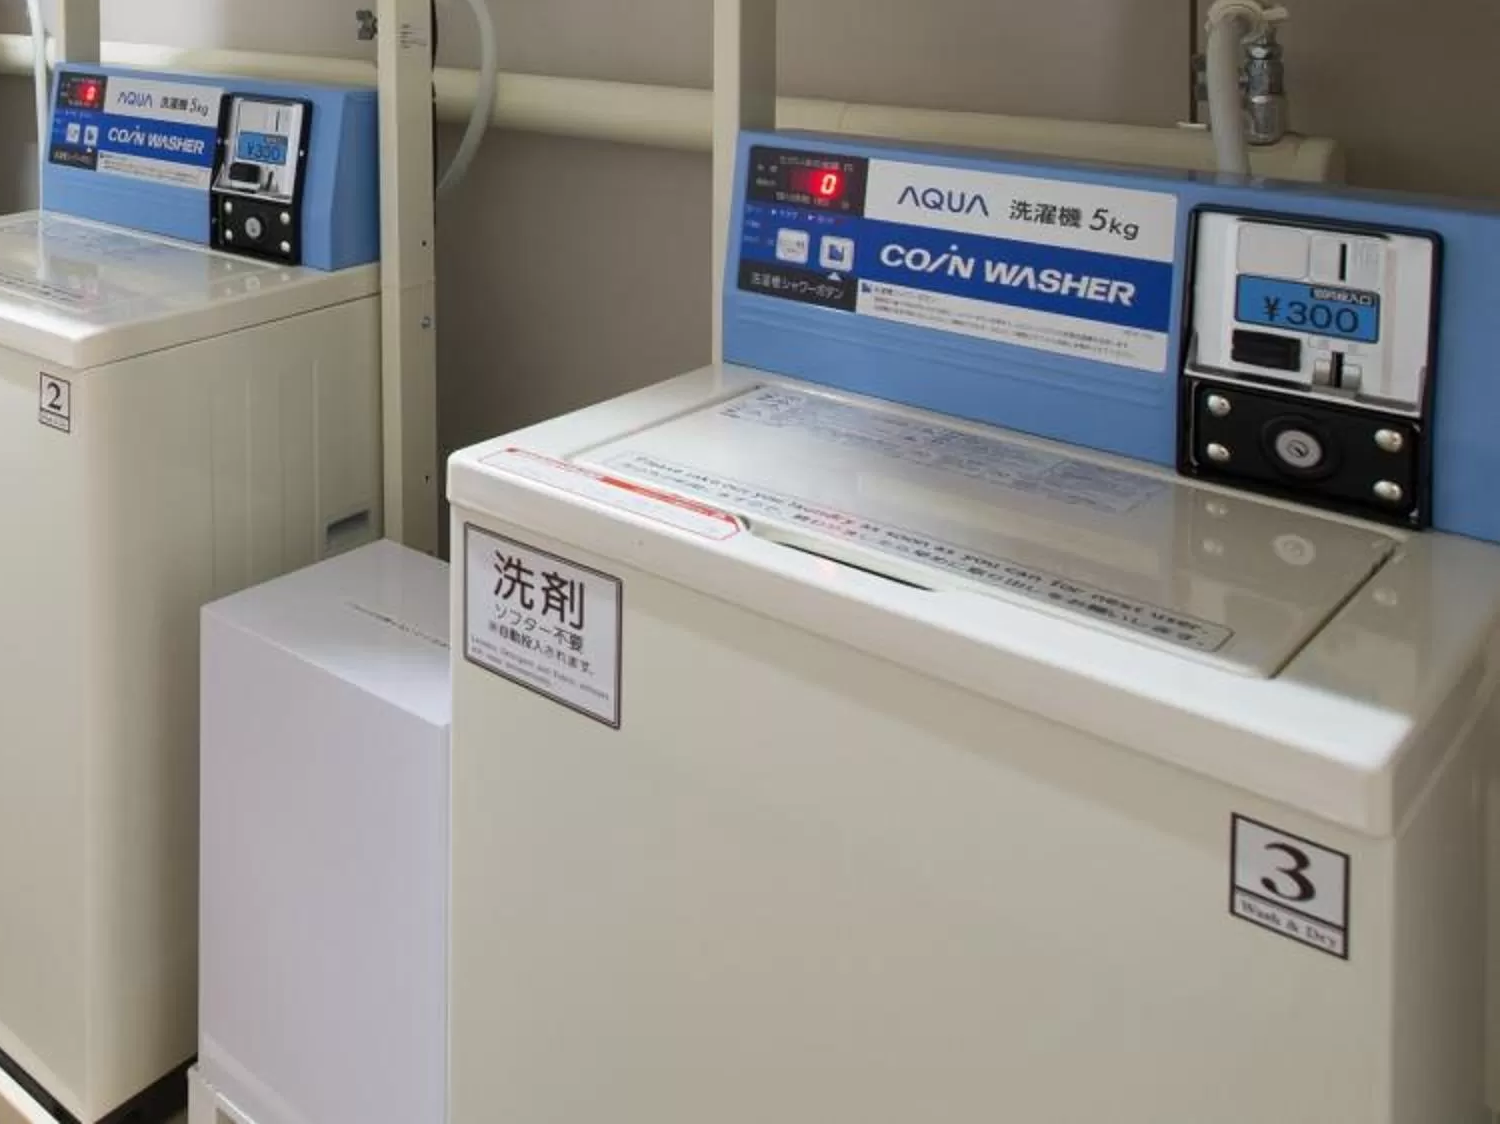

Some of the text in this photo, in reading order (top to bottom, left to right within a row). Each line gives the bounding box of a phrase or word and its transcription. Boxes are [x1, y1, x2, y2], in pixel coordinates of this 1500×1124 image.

[117, 90, 153, 109] AQUA
[147, 131, 205, 155] WASHER
[820, 173, 837, 195] 0
[898, 185, 1140, 241] AQUA 洗濯機 5kg
[984, 260, 1137, 307] WASHER
[1263, 295, 1359, 333] ¥300
[47, 381, 62, 411] 2
[493, 549, 585, 631] 洗剤
[495, 603, 584, 652] ソフター不要
[1260, 841, 1317, 903] 3
[1241, 899, 1337, 950] Wash & Dry
